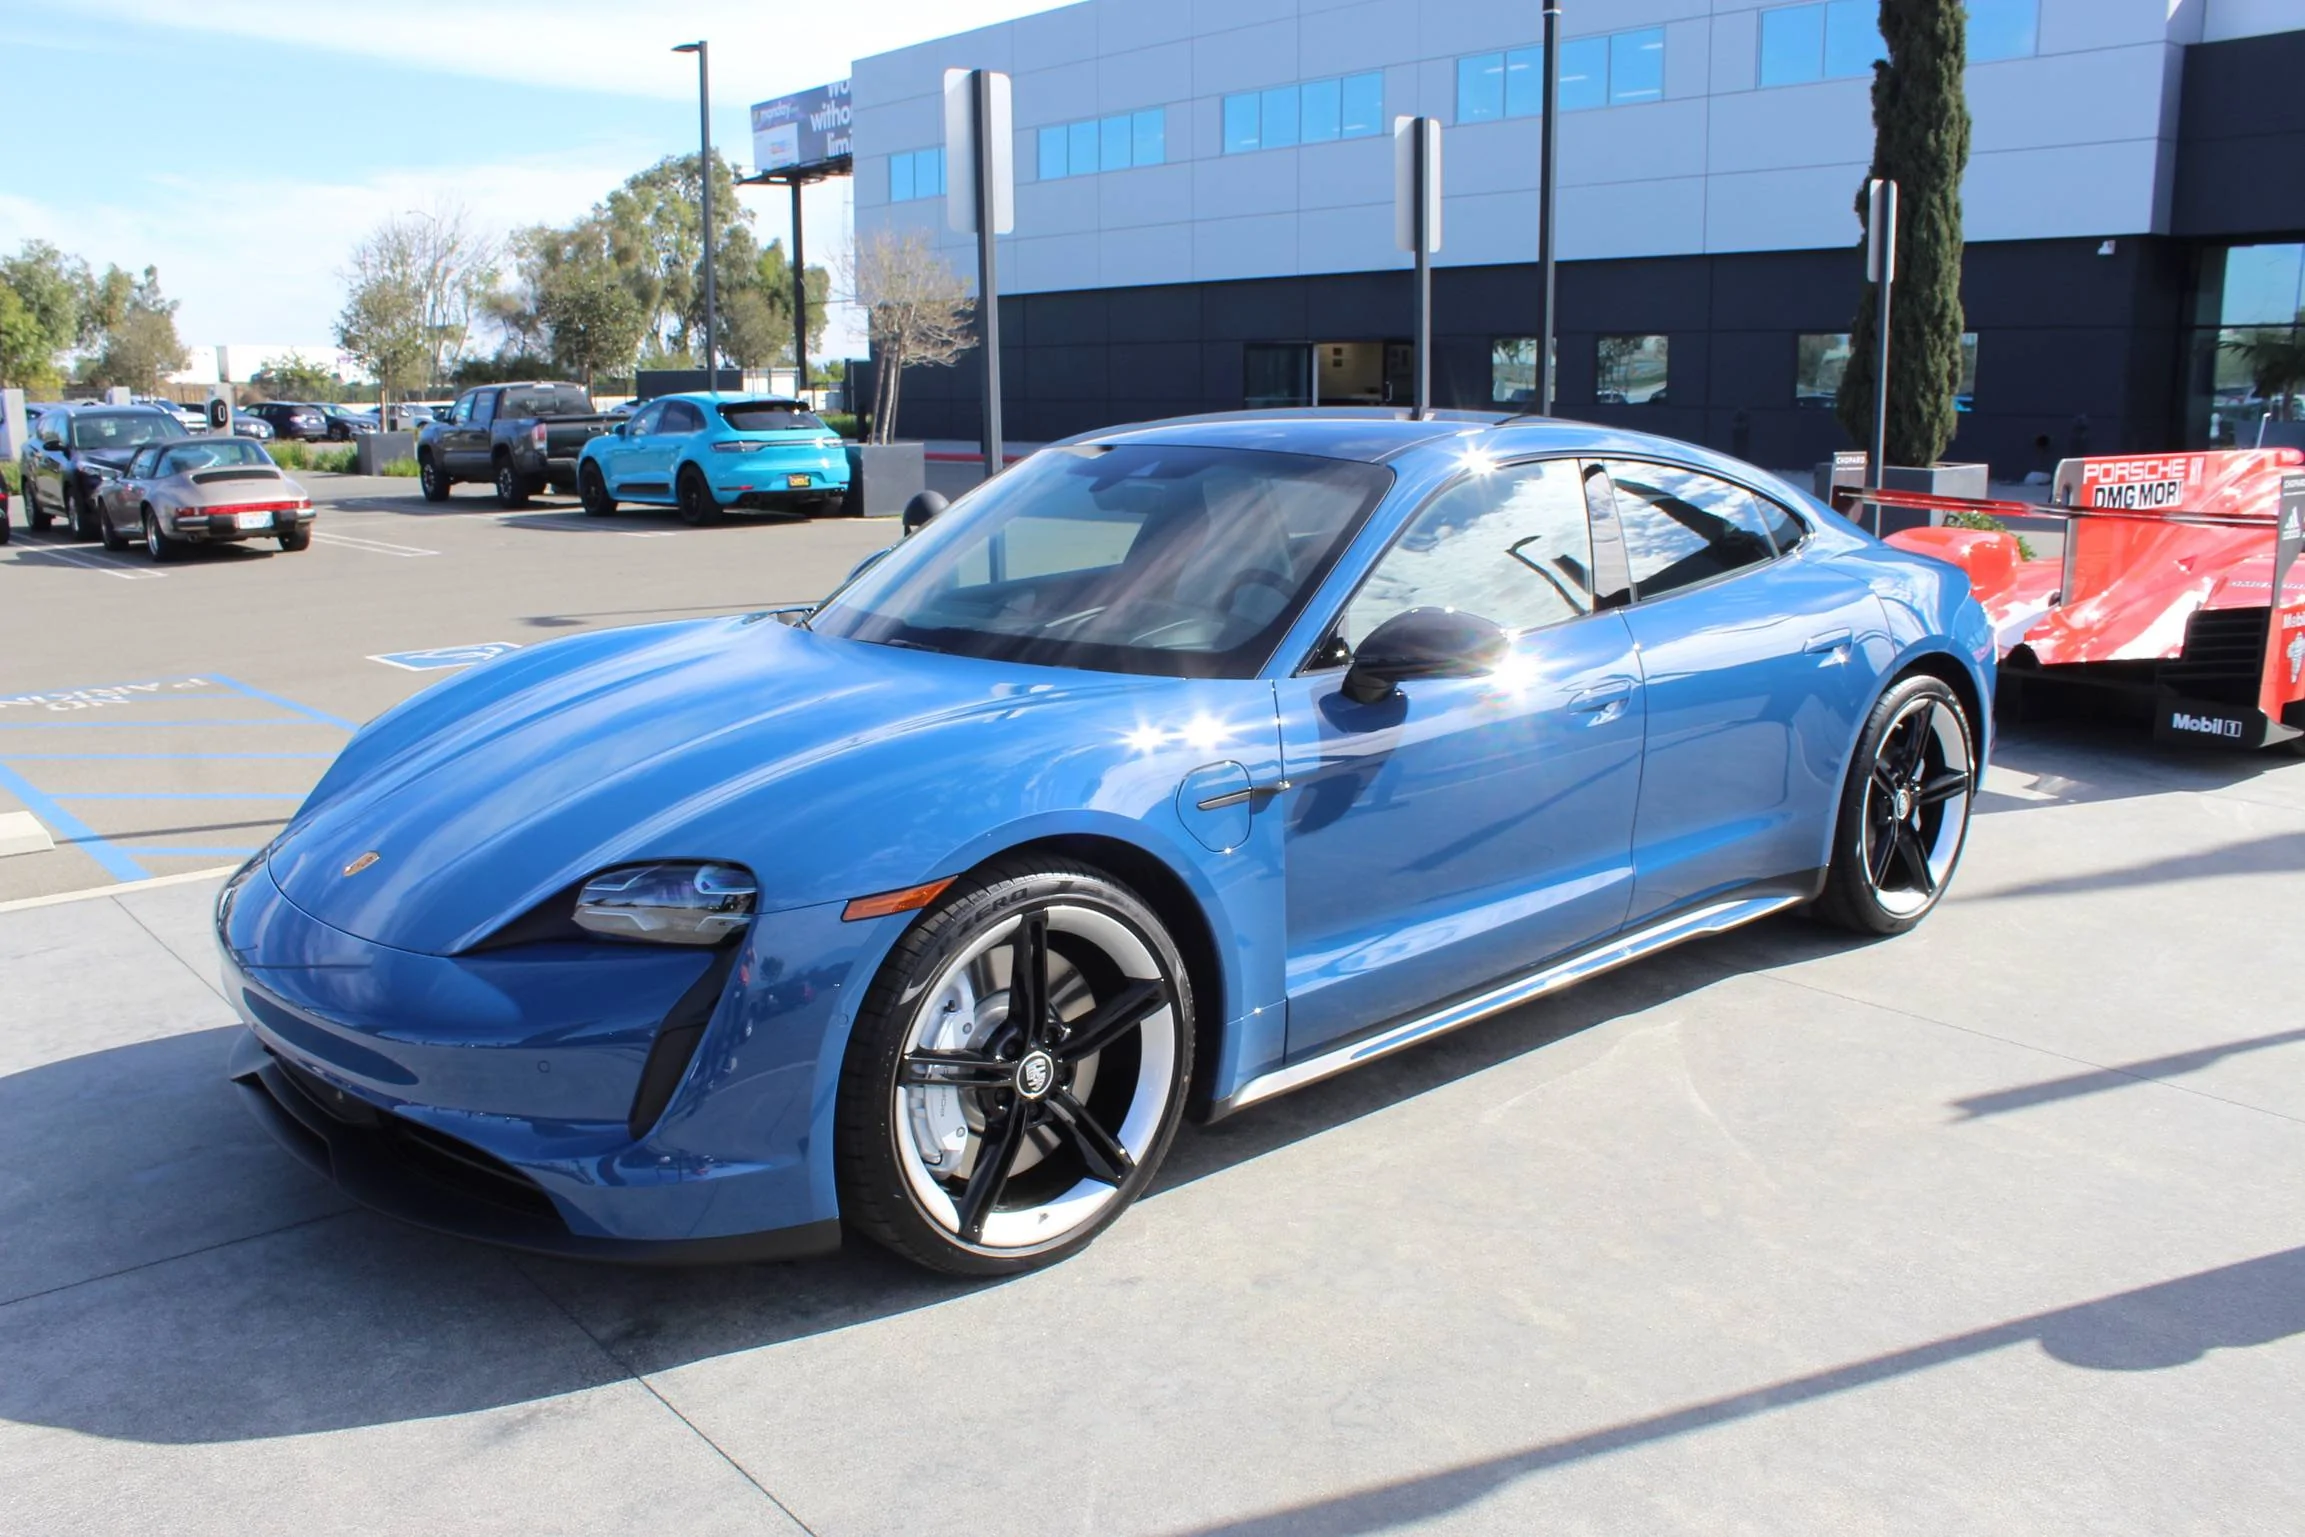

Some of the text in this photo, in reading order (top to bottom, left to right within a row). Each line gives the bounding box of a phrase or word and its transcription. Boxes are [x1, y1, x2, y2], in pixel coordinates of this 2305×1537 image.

[2083, 457, 2187, 485] PORSCHE
[2094, 485, 2136, 509] DMG
[2172, 712, 2223, 735] Mobil
